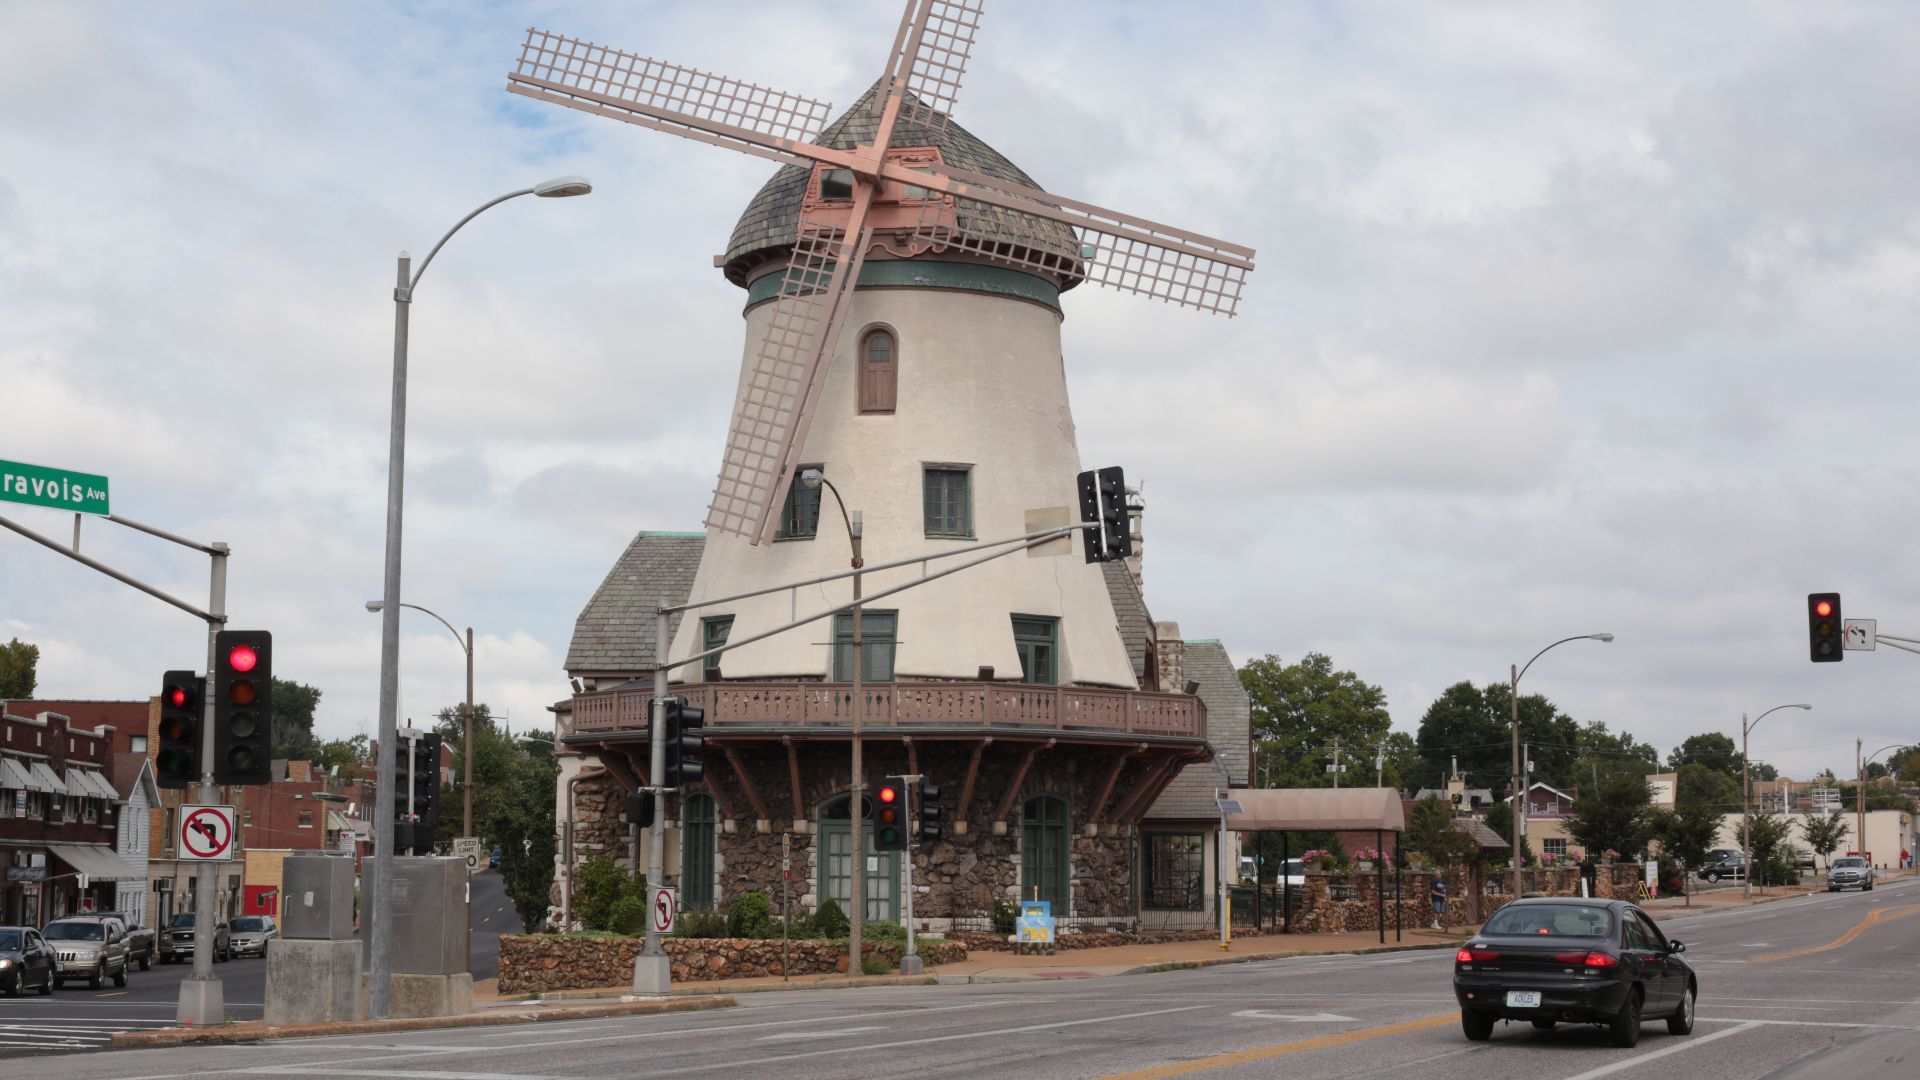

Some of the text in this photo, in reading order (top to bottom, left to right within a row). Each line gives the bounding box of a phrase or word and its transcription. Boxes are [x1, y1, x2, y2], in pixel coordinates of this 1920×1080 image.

[3, 473, 106, 503] ravois Ave
[467, 854, 477, 867] 0
